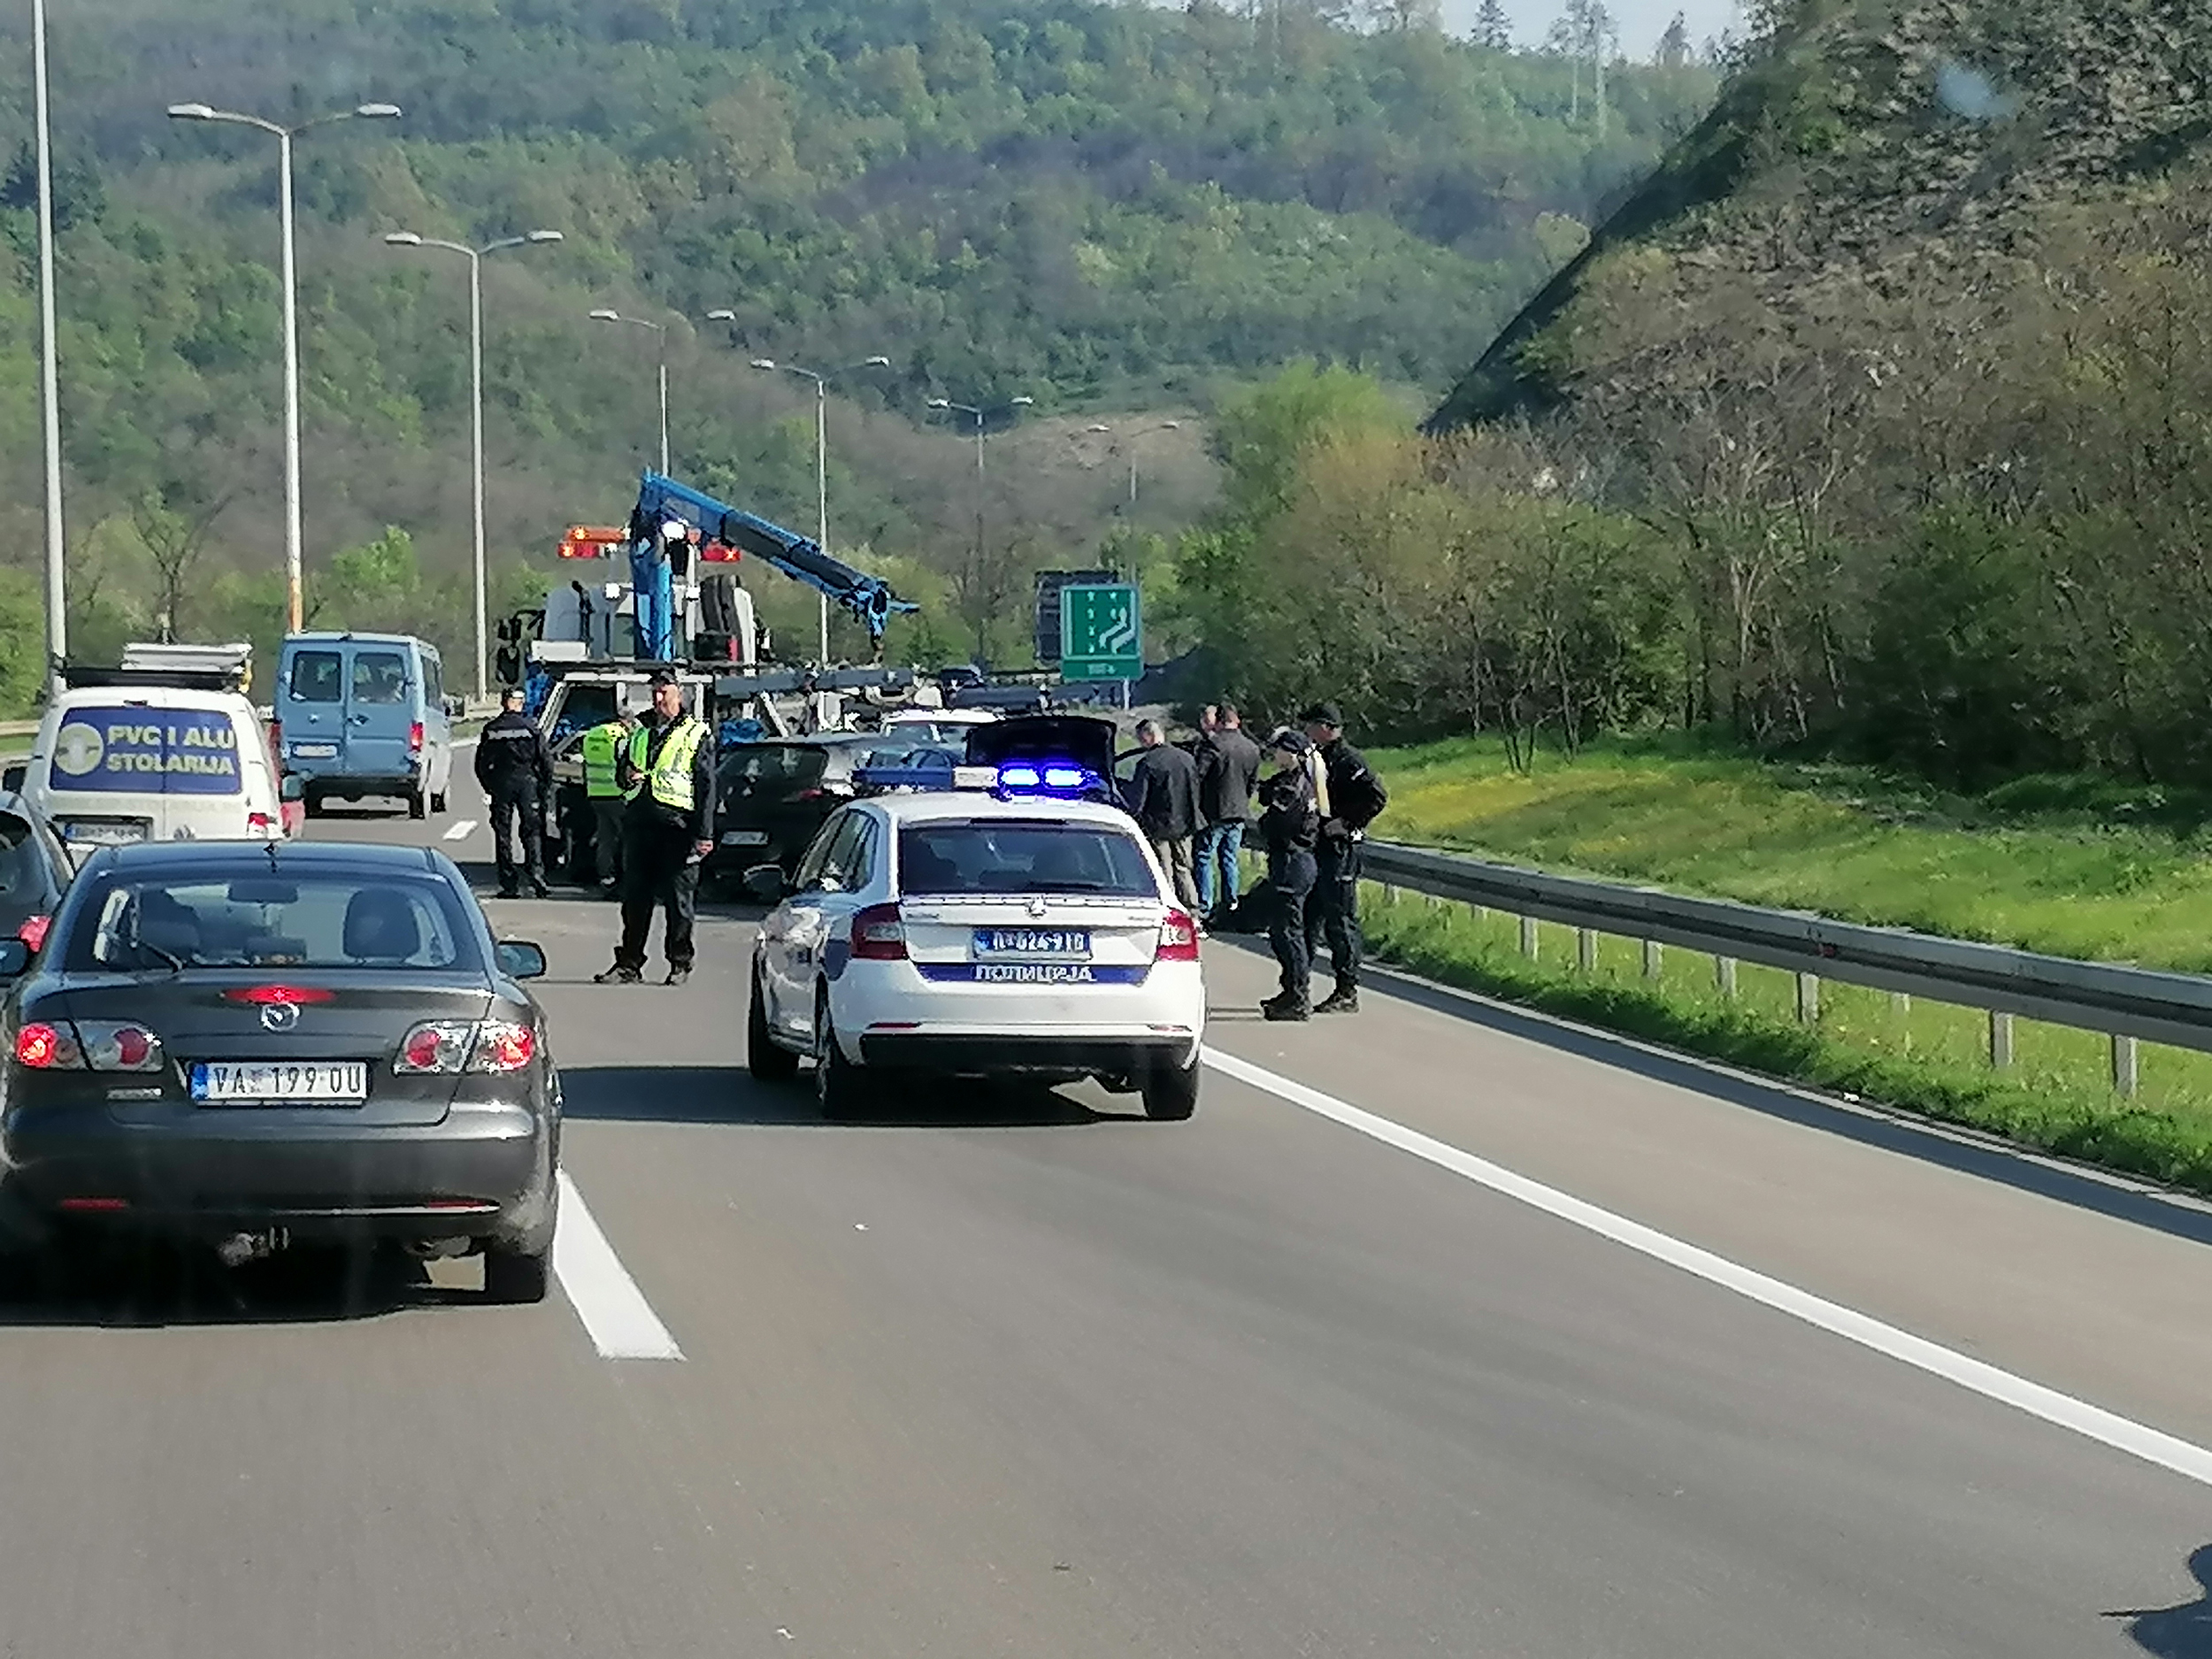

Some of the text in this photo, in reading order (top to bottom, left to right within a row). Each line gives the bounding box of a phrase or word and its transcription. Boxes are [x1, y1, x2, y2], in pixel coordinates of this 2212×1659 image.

[107, 726, 235, 749] PVC I ALU
[106, 754, 235, 775] STOLARIJA
[975, 965, 1097, 984] ПОЛИЦИЈА
[214, 1067, 246, 1094] VA
